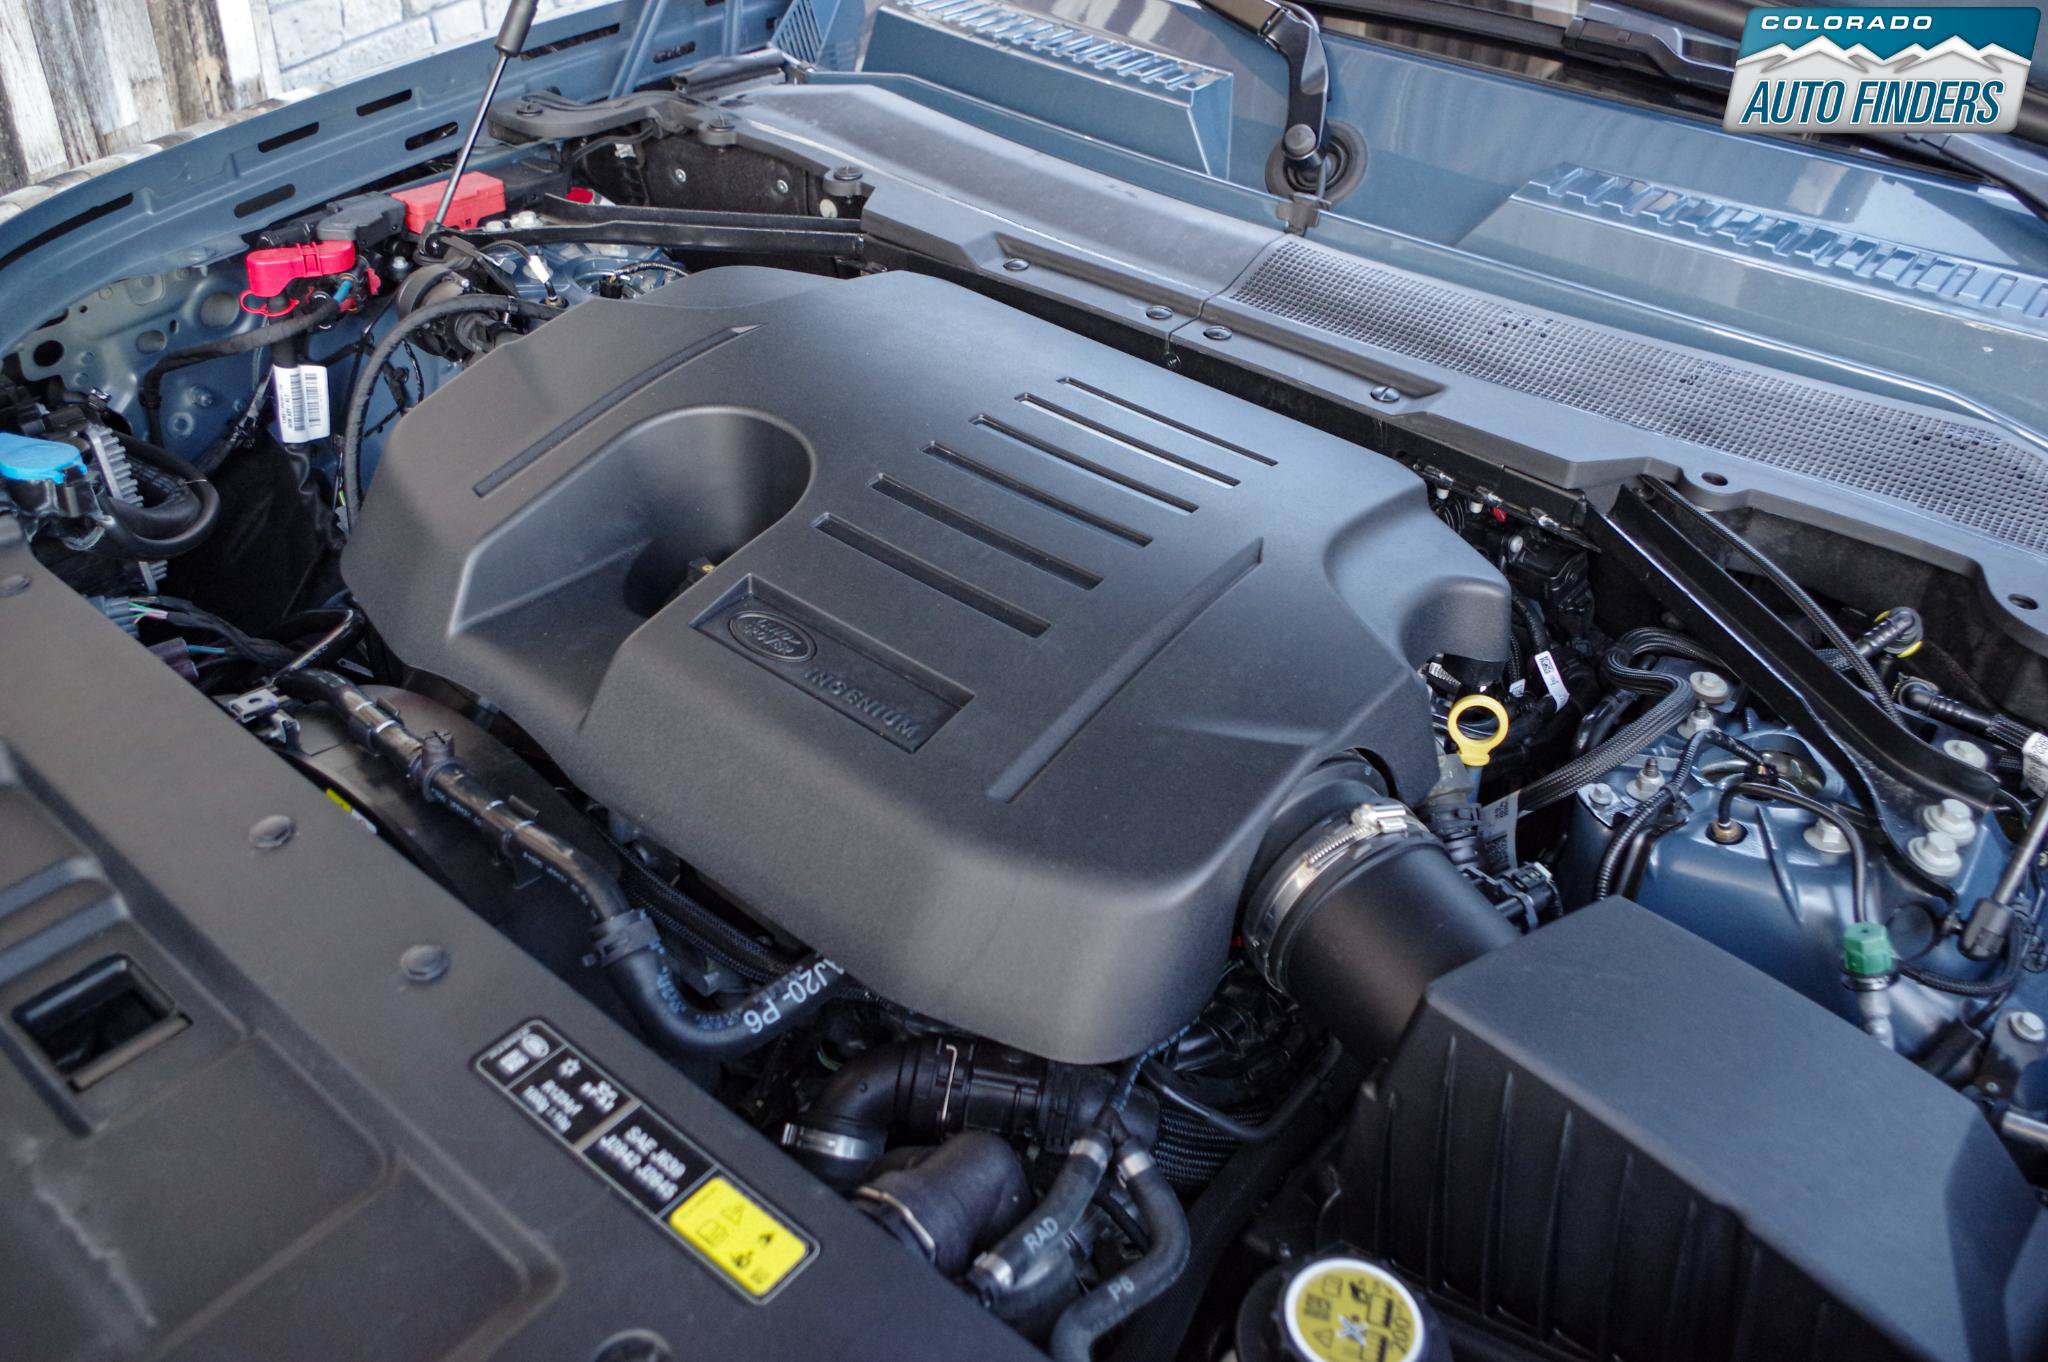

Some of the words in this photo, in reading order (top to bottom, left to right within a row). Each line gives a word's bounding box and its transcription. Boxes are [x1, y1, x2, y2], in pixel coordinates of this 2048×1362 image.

[804, 668, 922, 738] INGENIUM
[743, 998, 781, 1034] P6
[624, 1126, 658, 1156] SAE
[1023, 1216, 1059, 1255] RAD
[1107, 1275, 1135, 1302] P6
